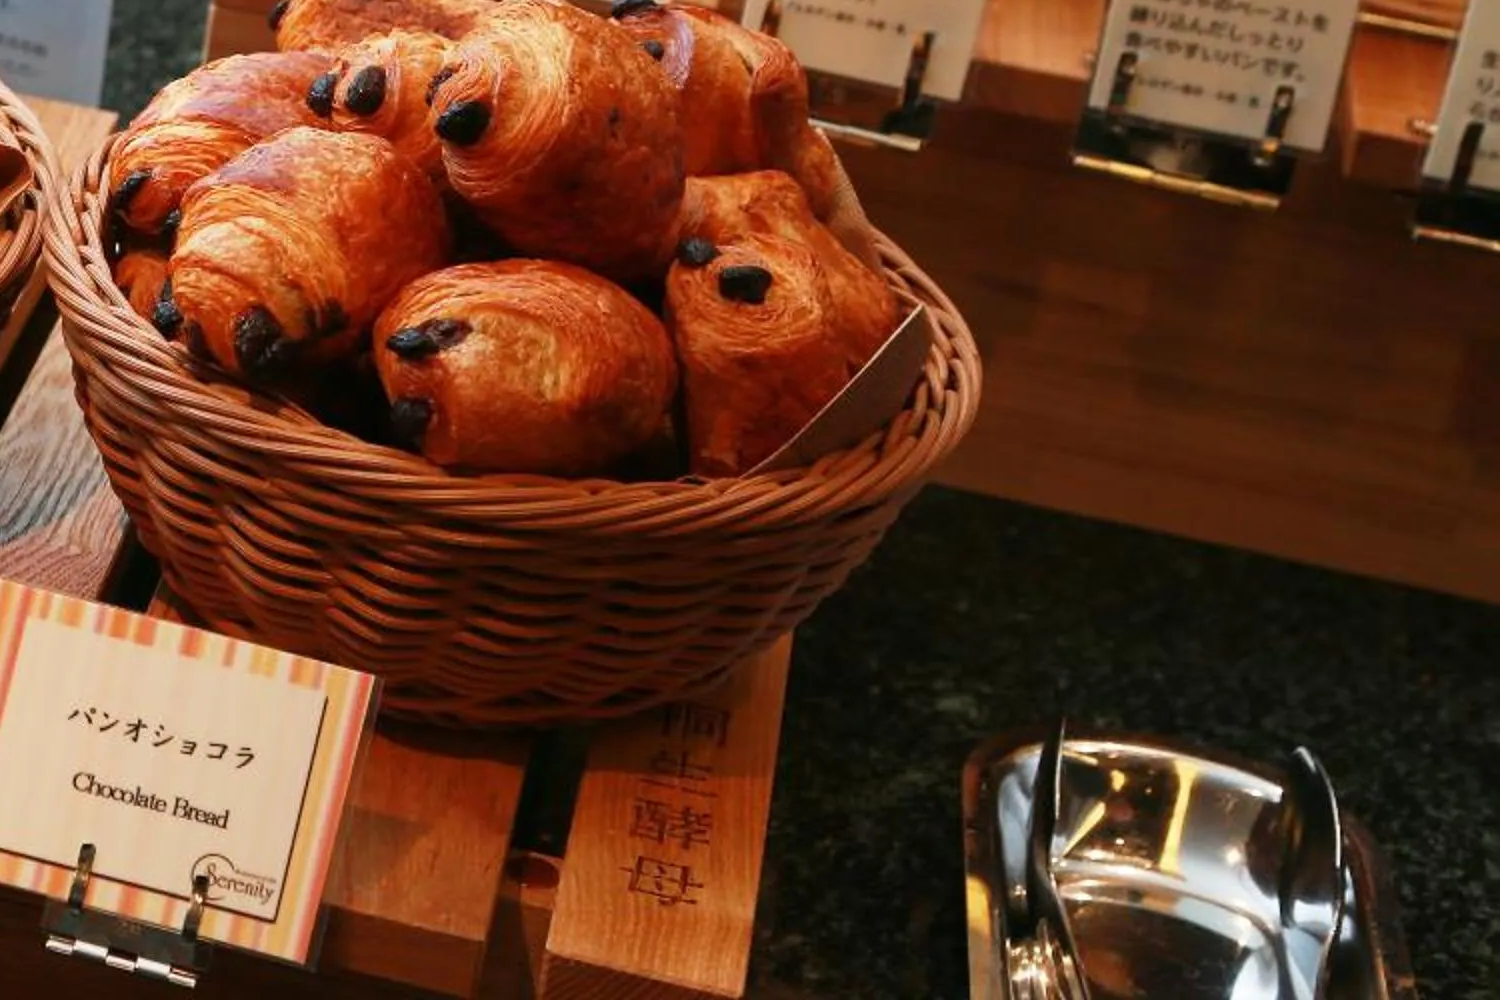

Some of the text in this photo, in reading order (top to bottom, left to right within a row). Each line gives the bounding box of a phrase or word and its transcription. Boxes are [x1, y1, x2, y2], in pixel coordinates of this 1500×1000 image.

[1129, 5, 1306, 53] 練り込んだしっとり
[67, 705, 257, 770] パンオショコラ
[71, 771, 231, 831] Chocolate Bread
